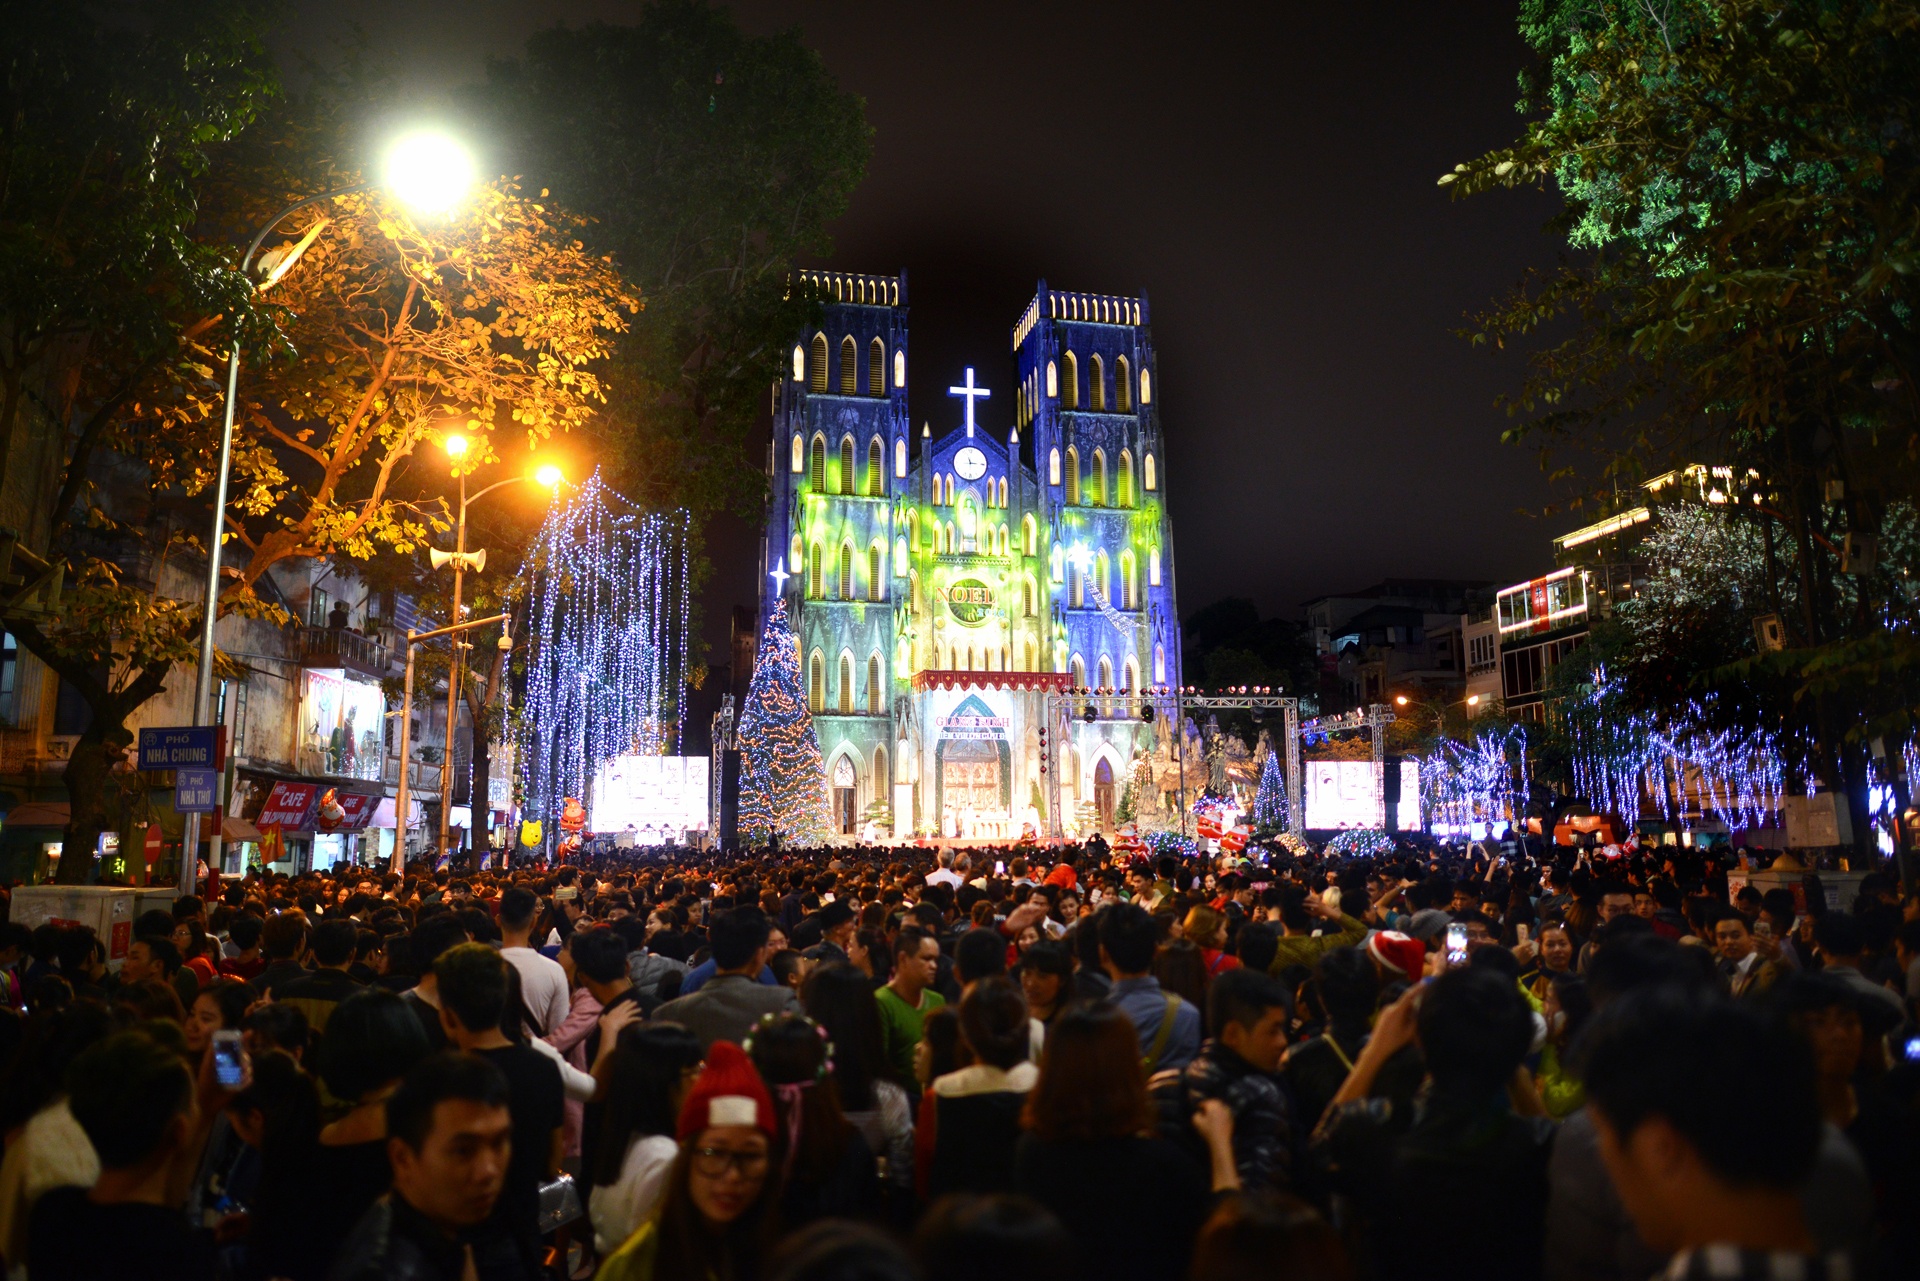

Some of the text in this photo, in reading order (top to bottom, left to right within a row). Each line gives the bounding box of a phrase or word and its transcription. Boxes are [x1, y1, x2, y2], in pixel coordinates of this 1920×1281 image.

[935, 586, 996, 604] NOEL
[165, 732, 190, 744] PHỐ
[146, 746, 207, 763] NHÀ CHUNG
[190, 774, 204, 785] PHỐ
[180, 787, 211, 805] NHÀ THỜ
[280, 789, 307, 807] CAFÉ
